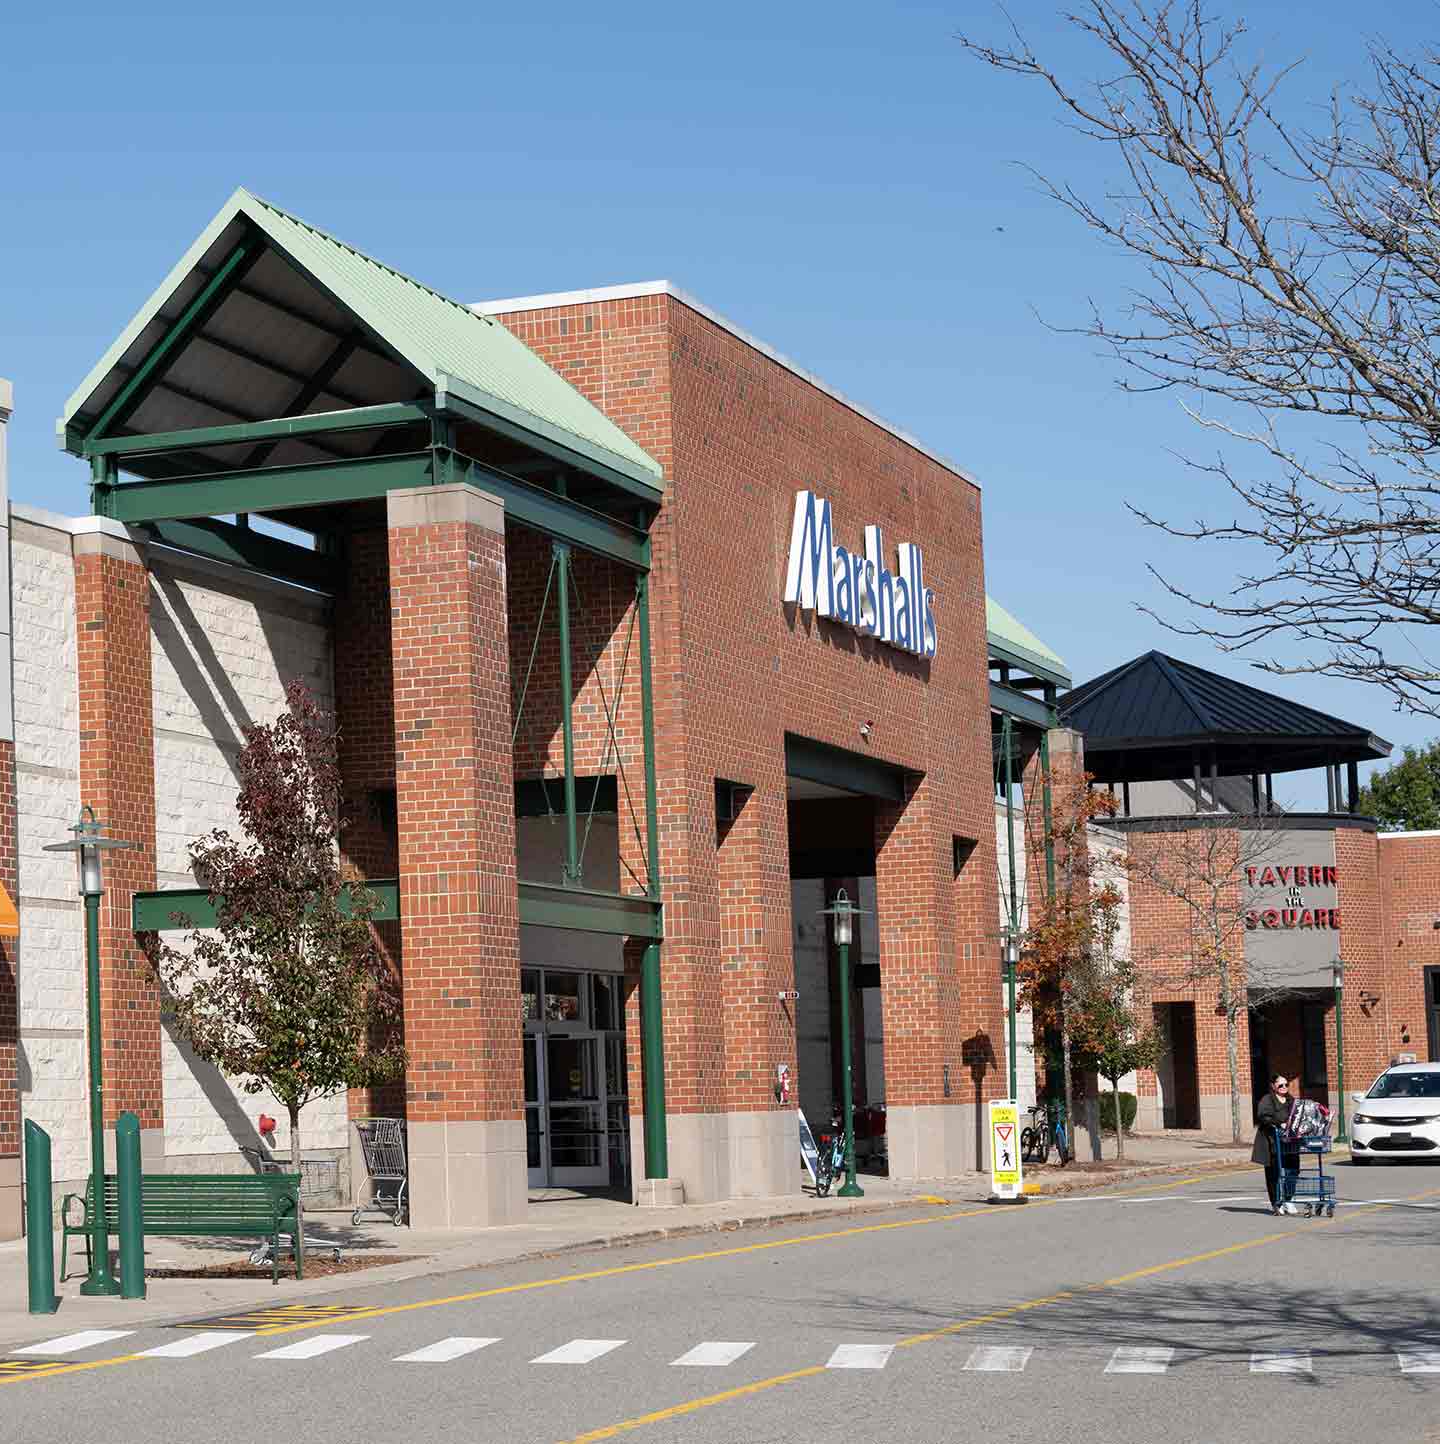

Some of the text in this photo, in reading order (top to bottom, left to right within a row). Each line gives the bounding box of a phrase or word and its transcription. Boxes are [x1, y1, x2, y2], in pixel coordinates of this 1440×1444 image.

[783, 490, 937, 657] Marshalls
[1245, 866, 1339, 887] TAVERN
[1288, 887, 1301, 896] IN
[1286, 898, 1305, 907] THE
[1246, 909, 1341, 930] SQUARE
